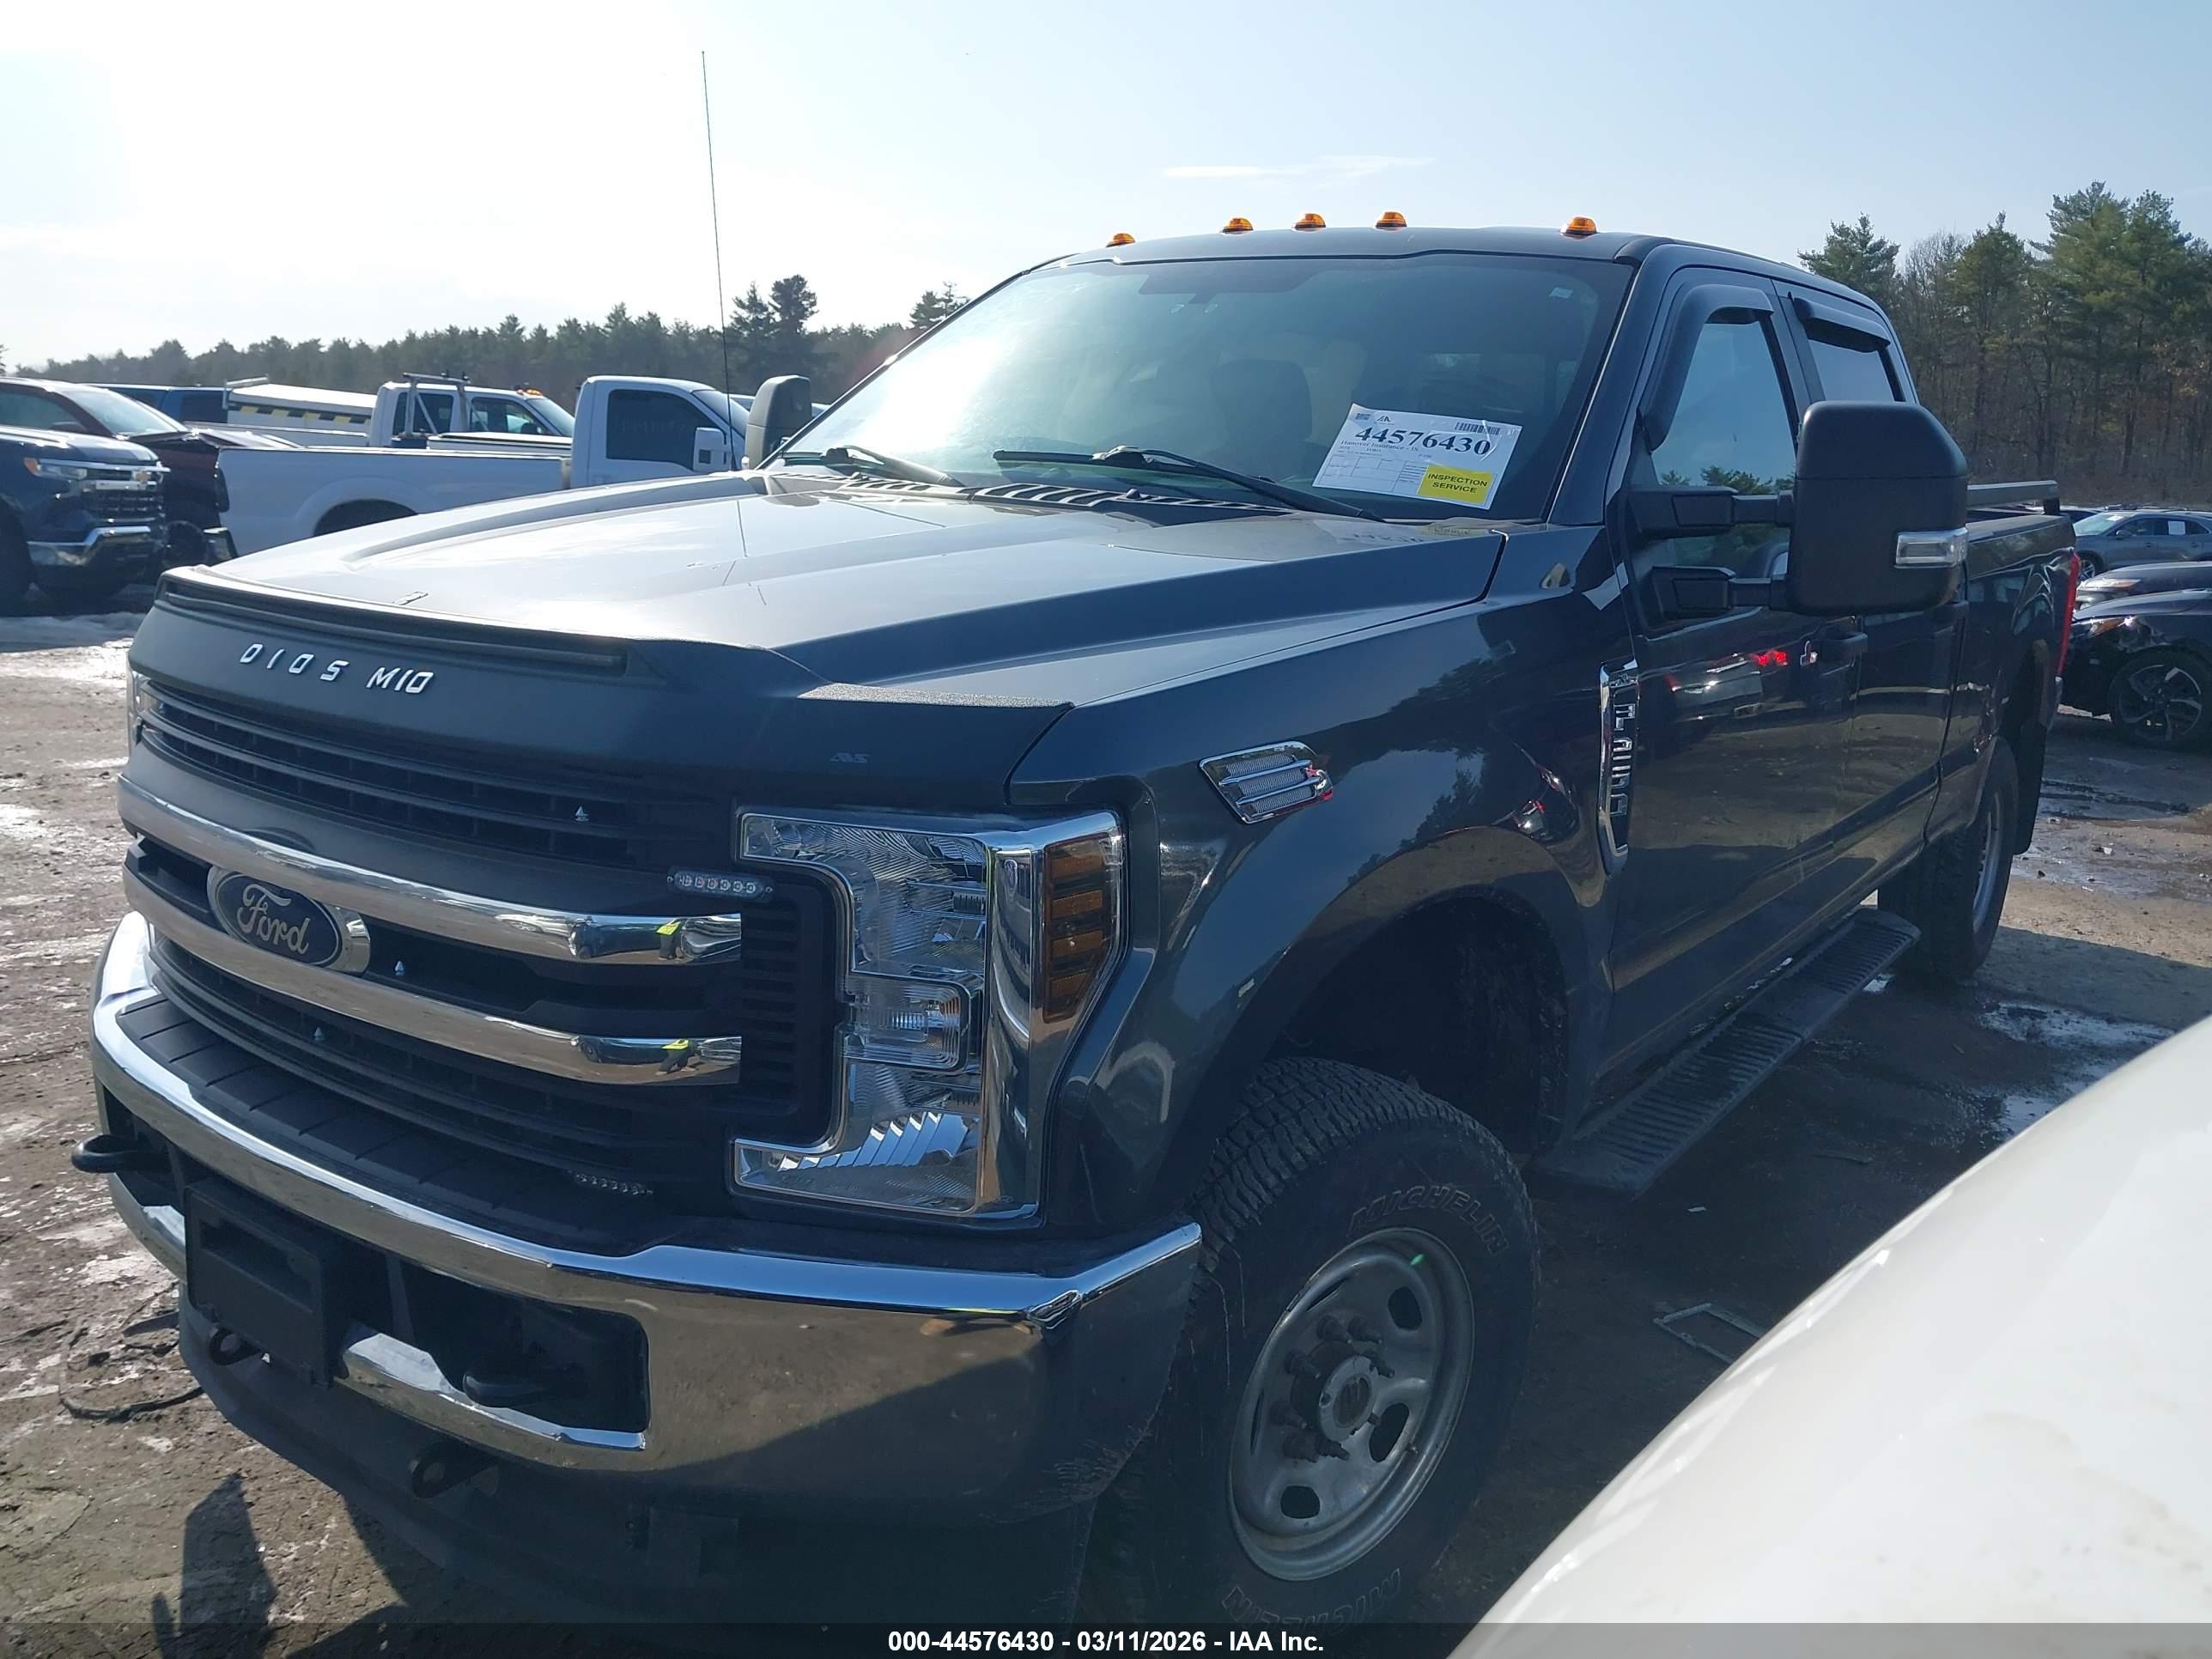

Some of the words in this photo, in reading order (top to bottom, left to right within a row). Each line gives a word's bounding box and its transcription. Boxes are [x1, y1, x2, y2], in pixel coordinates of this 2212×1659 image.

[1355, 427, 1492, 455] 44576430
[1427, 472, 1488, 487] INSPECTION
[1432, 481, 1478, 494] SERVICE
[236, 884, 311, 955] Ford
[1346, 1183, 1510, 1257] MICHELIN
